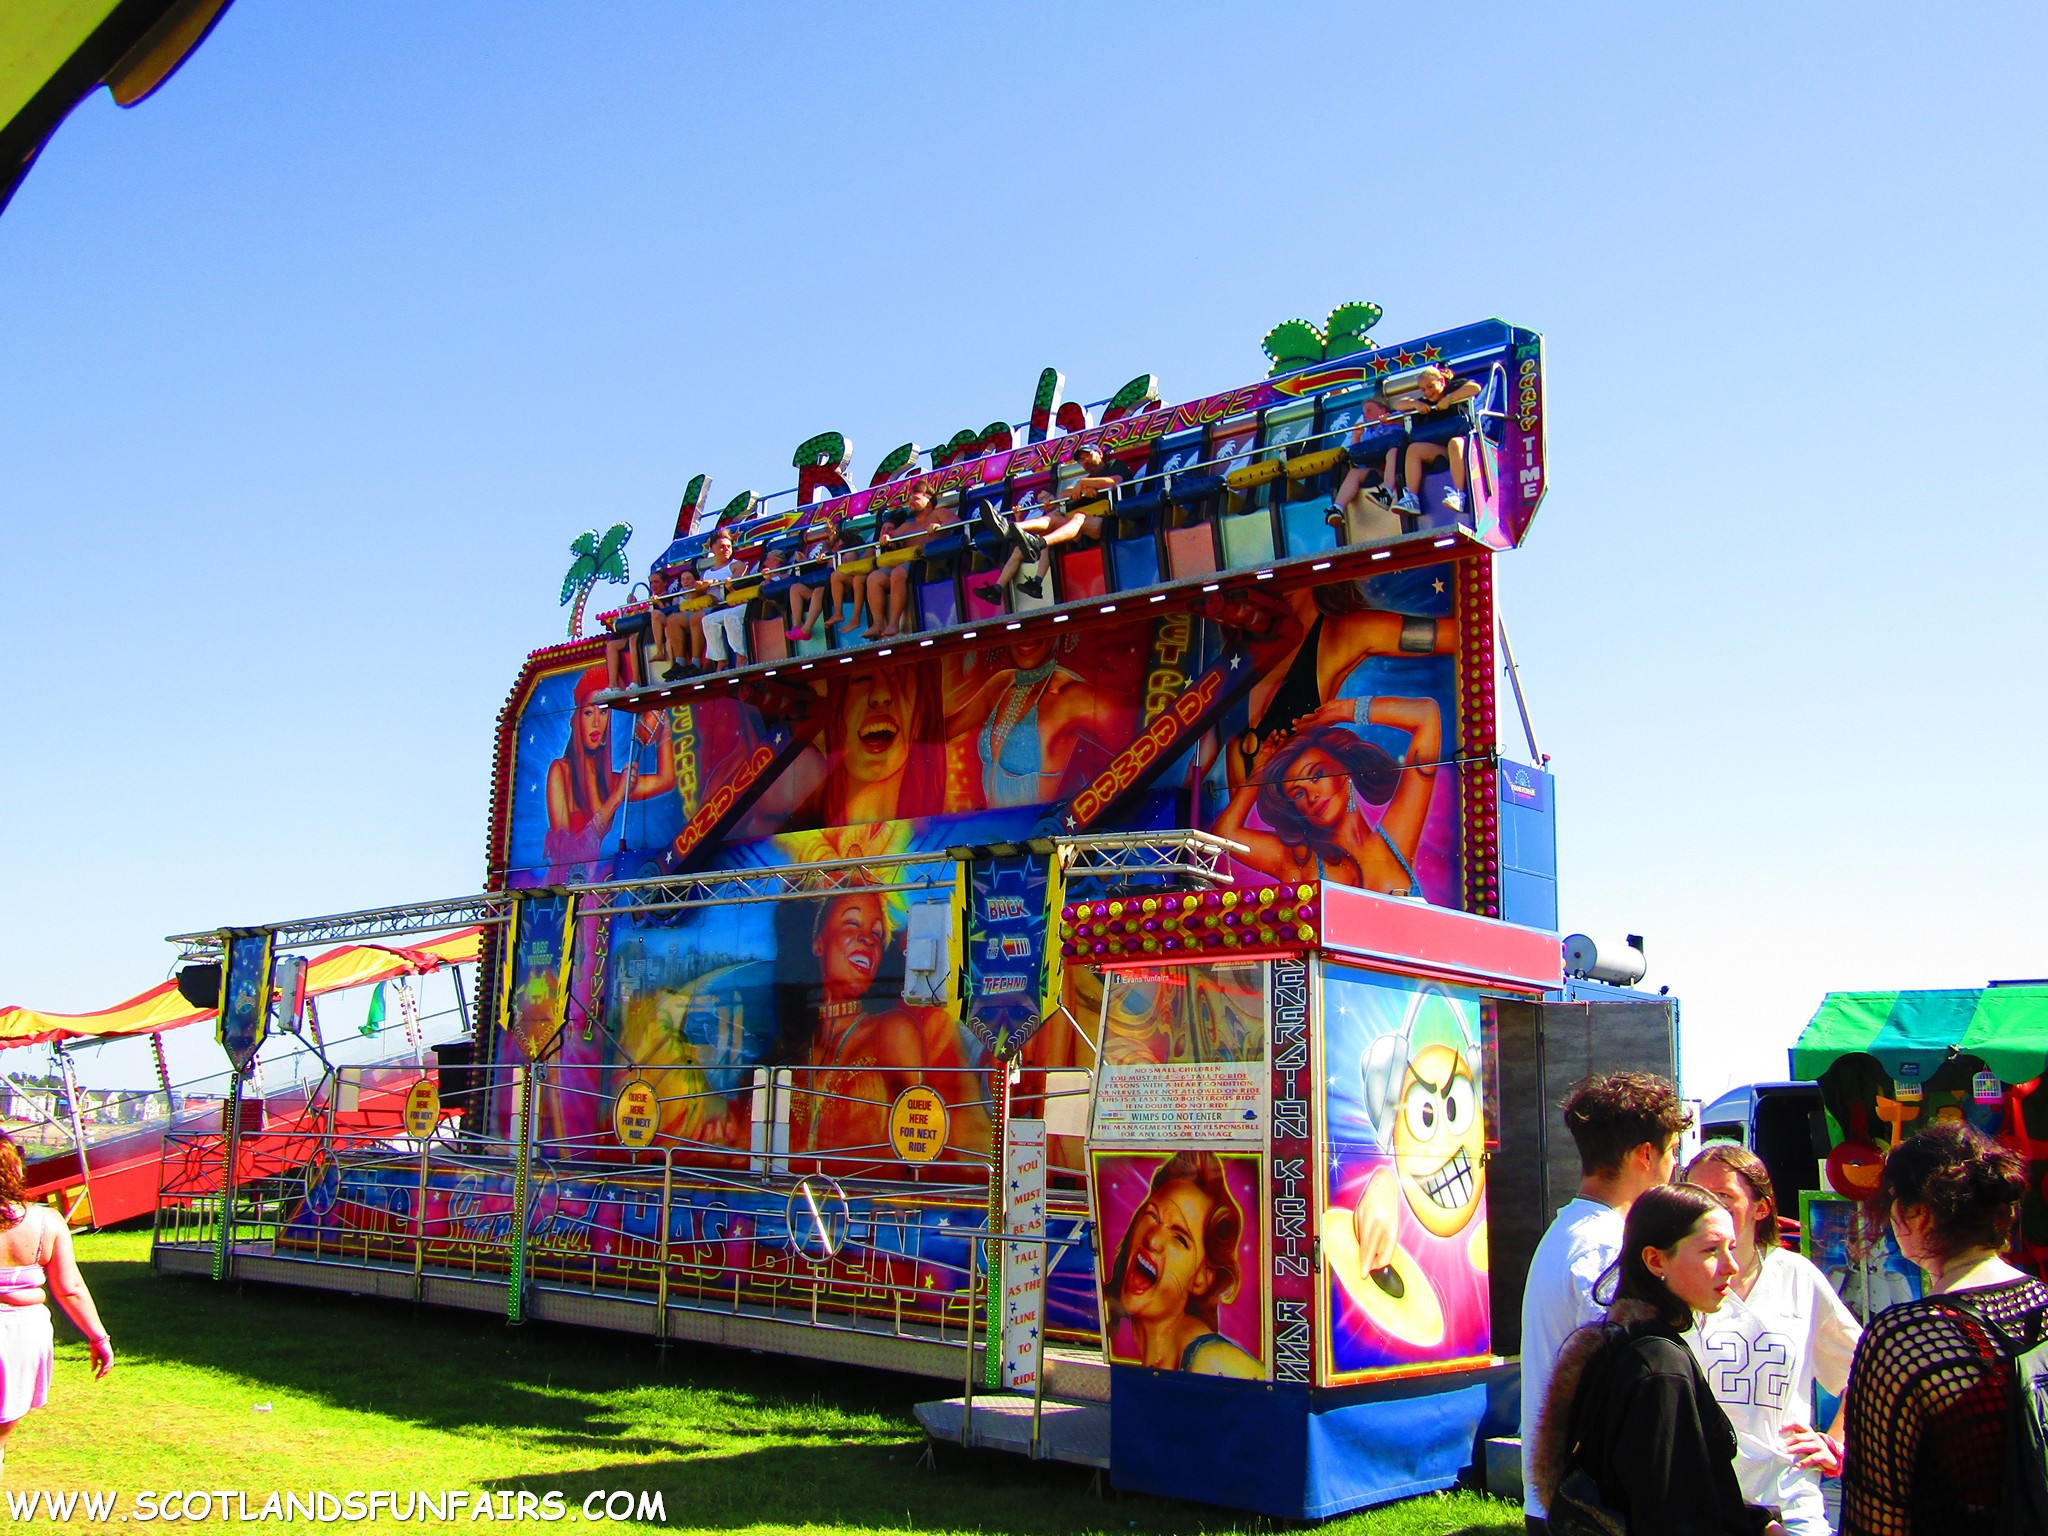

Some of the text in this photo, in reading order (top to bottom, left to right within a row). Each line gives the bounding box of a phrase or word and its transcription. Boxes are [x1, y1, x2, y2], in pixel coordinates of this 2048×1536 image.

[809, 498, 851, 526] LA
[1005, 384, 1261, 477] EXPERIENCE
[1519, 436, 1541, 498] TIME
[986, 898, 1031, 922] BACK
[982, 975, 1027, 995] TECHNO
[1122, 976, 1142, 984] Evans
[629, 1093, 647, 1103] QUEUE
[908, 1099, 931, 1110] QUEUE
[630, 1106, 645, 1114] HERE
[1131, 1113, 1159, 1121] WIMPS
[1196, 1112, 1222, 1120] ENTER
[622, 1117, 651, 1127] FOR NEXT
[909, 1114, 928, 1124] HERE
[629, 1130, 643, 1139] RIDE
[900, 1127, 937, 1140] FOR NEXT
[909, 1142, 927, 1152] RIDE
[1016, 1160, 1038, 1175] YOU
[1014, 1188, 1041, 1205] MUST
[1273, 1159, 1310, 1277] KICKIN
[1013, 1218, 1041, 1236] BE AS
[618, 1189, 728, 1280] HAS
[751, 1208, 922, 1302] BEEN
[1014, 1250, 1039, 1265] TALL
[1008, 1279, 1041, 1297] AS THE
[1014, 1310, 1036, 1325] LINE
[1018, 1343, 1032, 1354] TO
[1706, 1331, 1796, 1410] 22
[1013, 1372, 1035, 1387] RIDE
